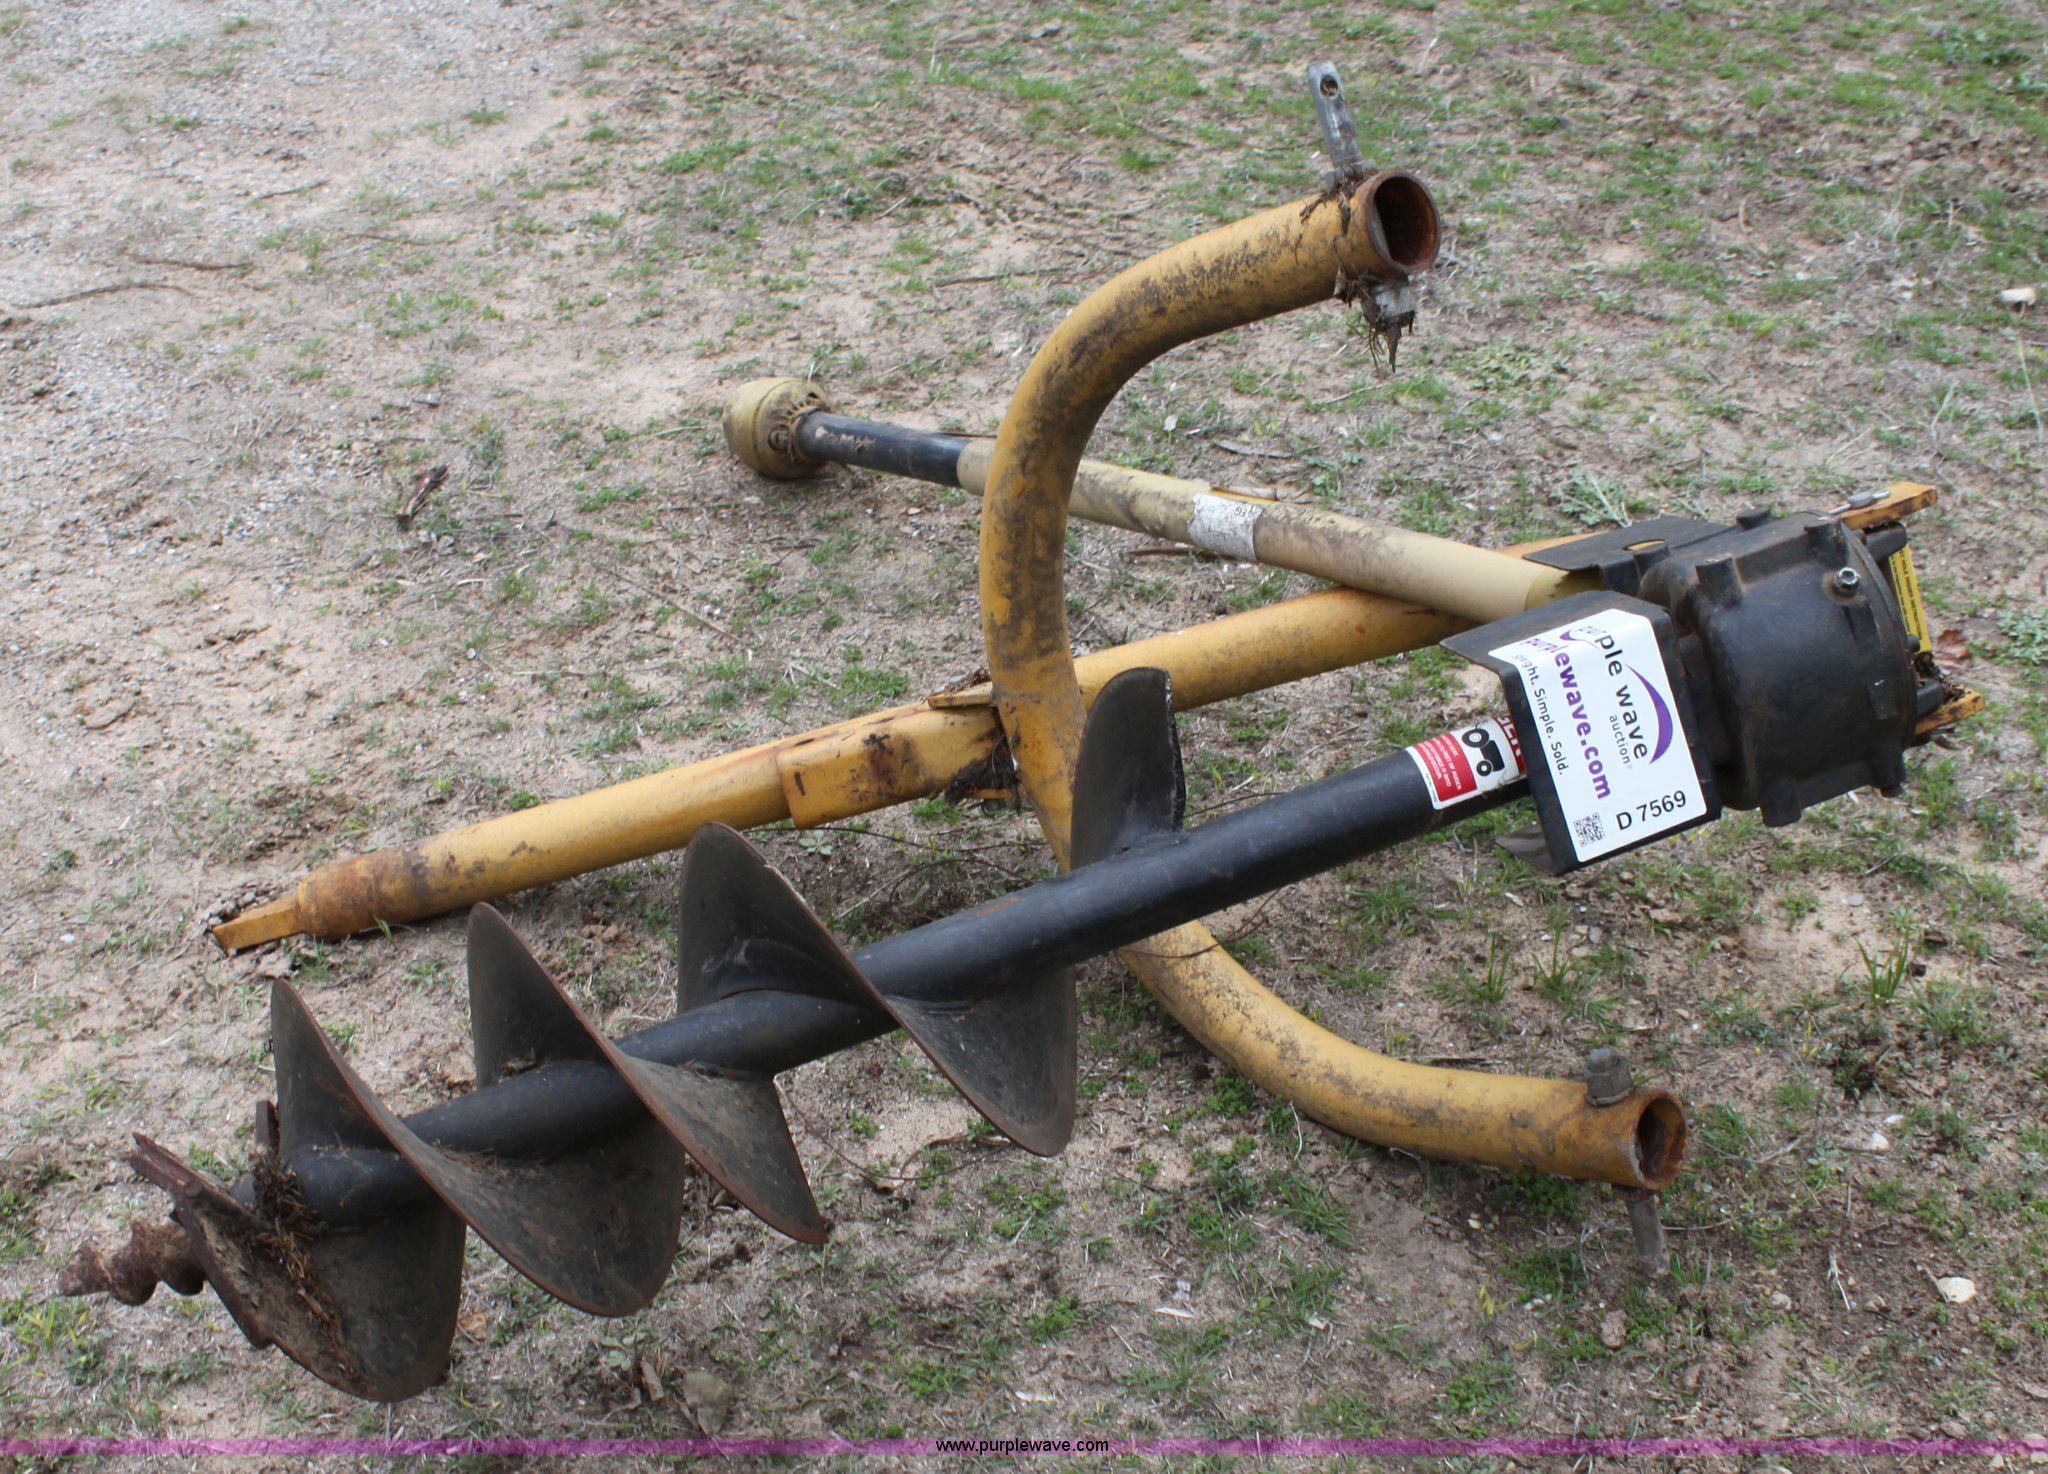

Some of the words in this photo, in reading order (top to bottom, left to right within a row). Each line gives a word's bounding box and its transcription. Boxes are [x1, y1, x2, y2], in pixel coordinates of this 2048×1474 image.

[1519, 637, 1612, 800] purplewave.com
[1533, 687, 1556, 739] Simple.
[1550, 741, 1569, 775] Sold.
[1609, 714, 1631, 765] auction
[1615, 684, 1648, 760] wave
[1616, 811, 1632, 831] D
[1636, 790, 1687, 823] 7569
